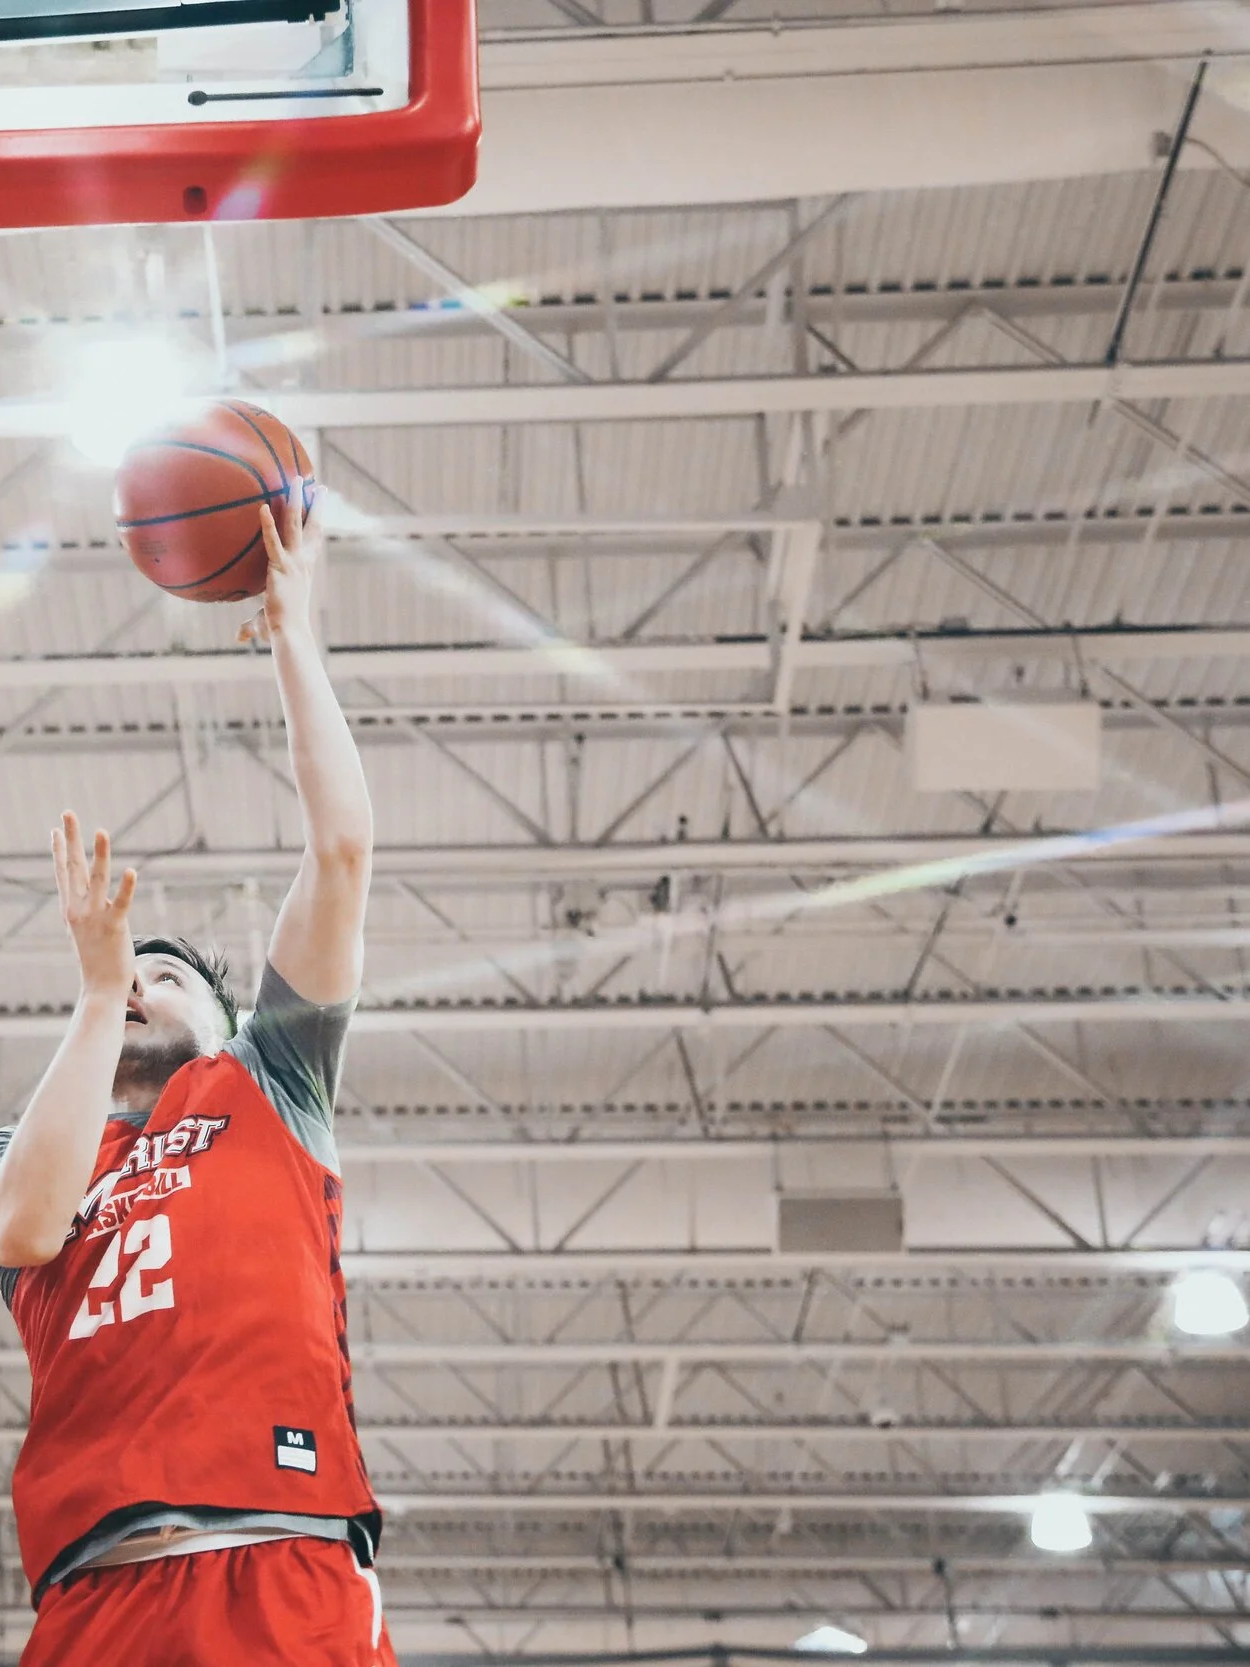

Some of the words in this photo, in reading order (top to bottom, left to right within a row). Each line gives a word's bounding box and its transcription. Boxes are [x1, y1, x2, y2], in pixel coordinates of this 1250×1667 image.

[65, 1117, 229, 1236] MRIST
[69, 1214, 174, 1340] 22
[287, 1431, 304, 1446] M
